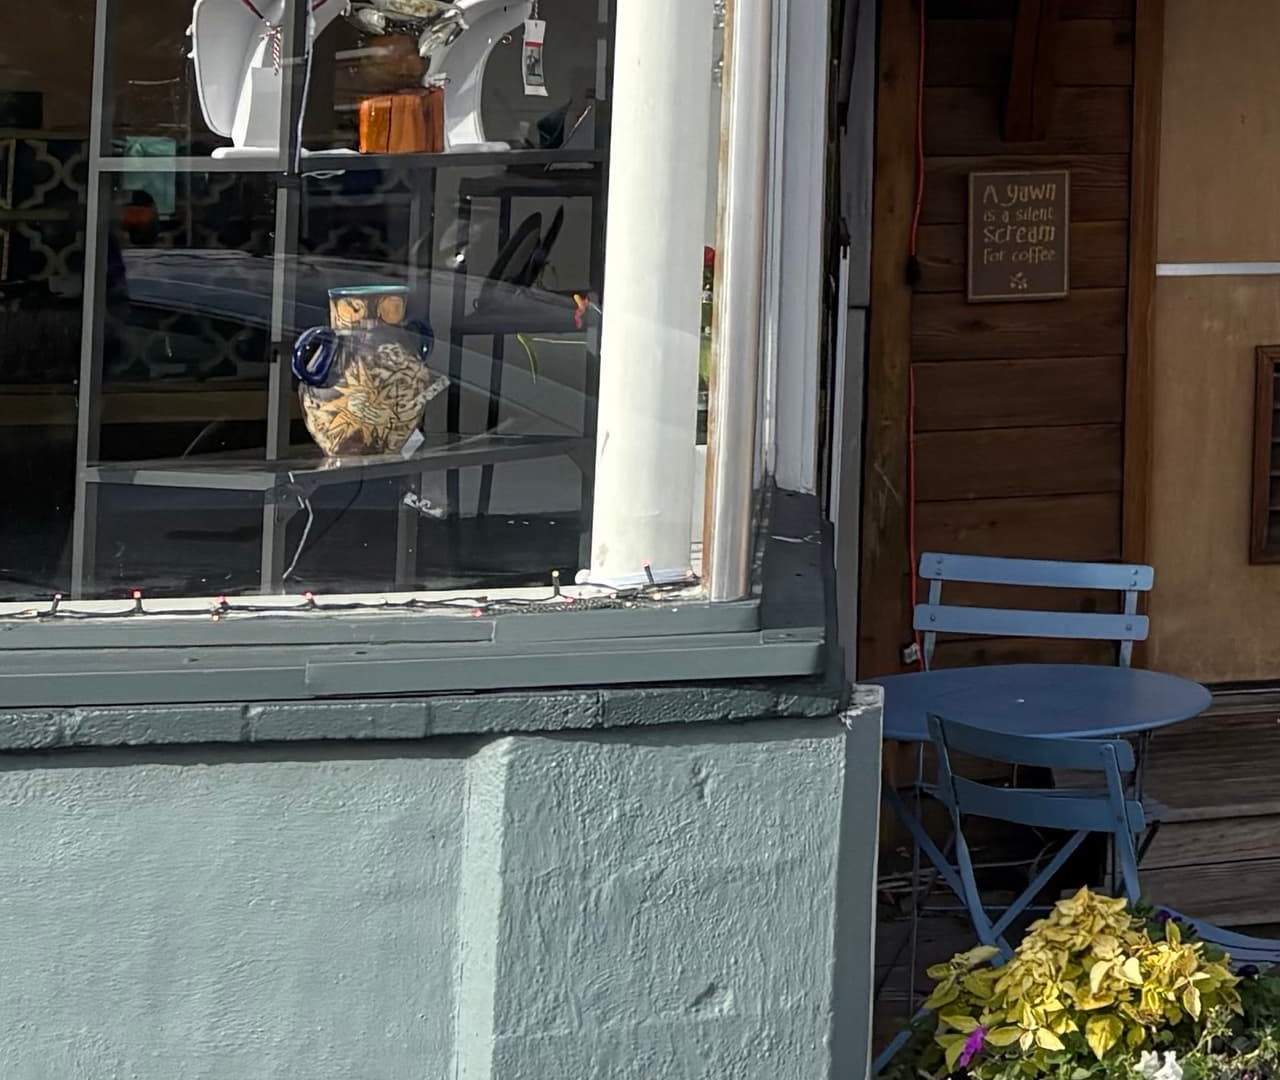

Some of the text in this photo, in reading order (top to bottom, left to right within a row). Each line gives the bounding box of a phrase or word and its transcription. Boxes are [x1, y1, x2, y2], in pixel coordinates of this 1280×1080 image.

[983, 182, 1057, 207] A yawn
[984, 205, 1054, 223] is a silent
[983, 224, 1056, 244] scream
[1011, 246, 1057, 265] coffee
